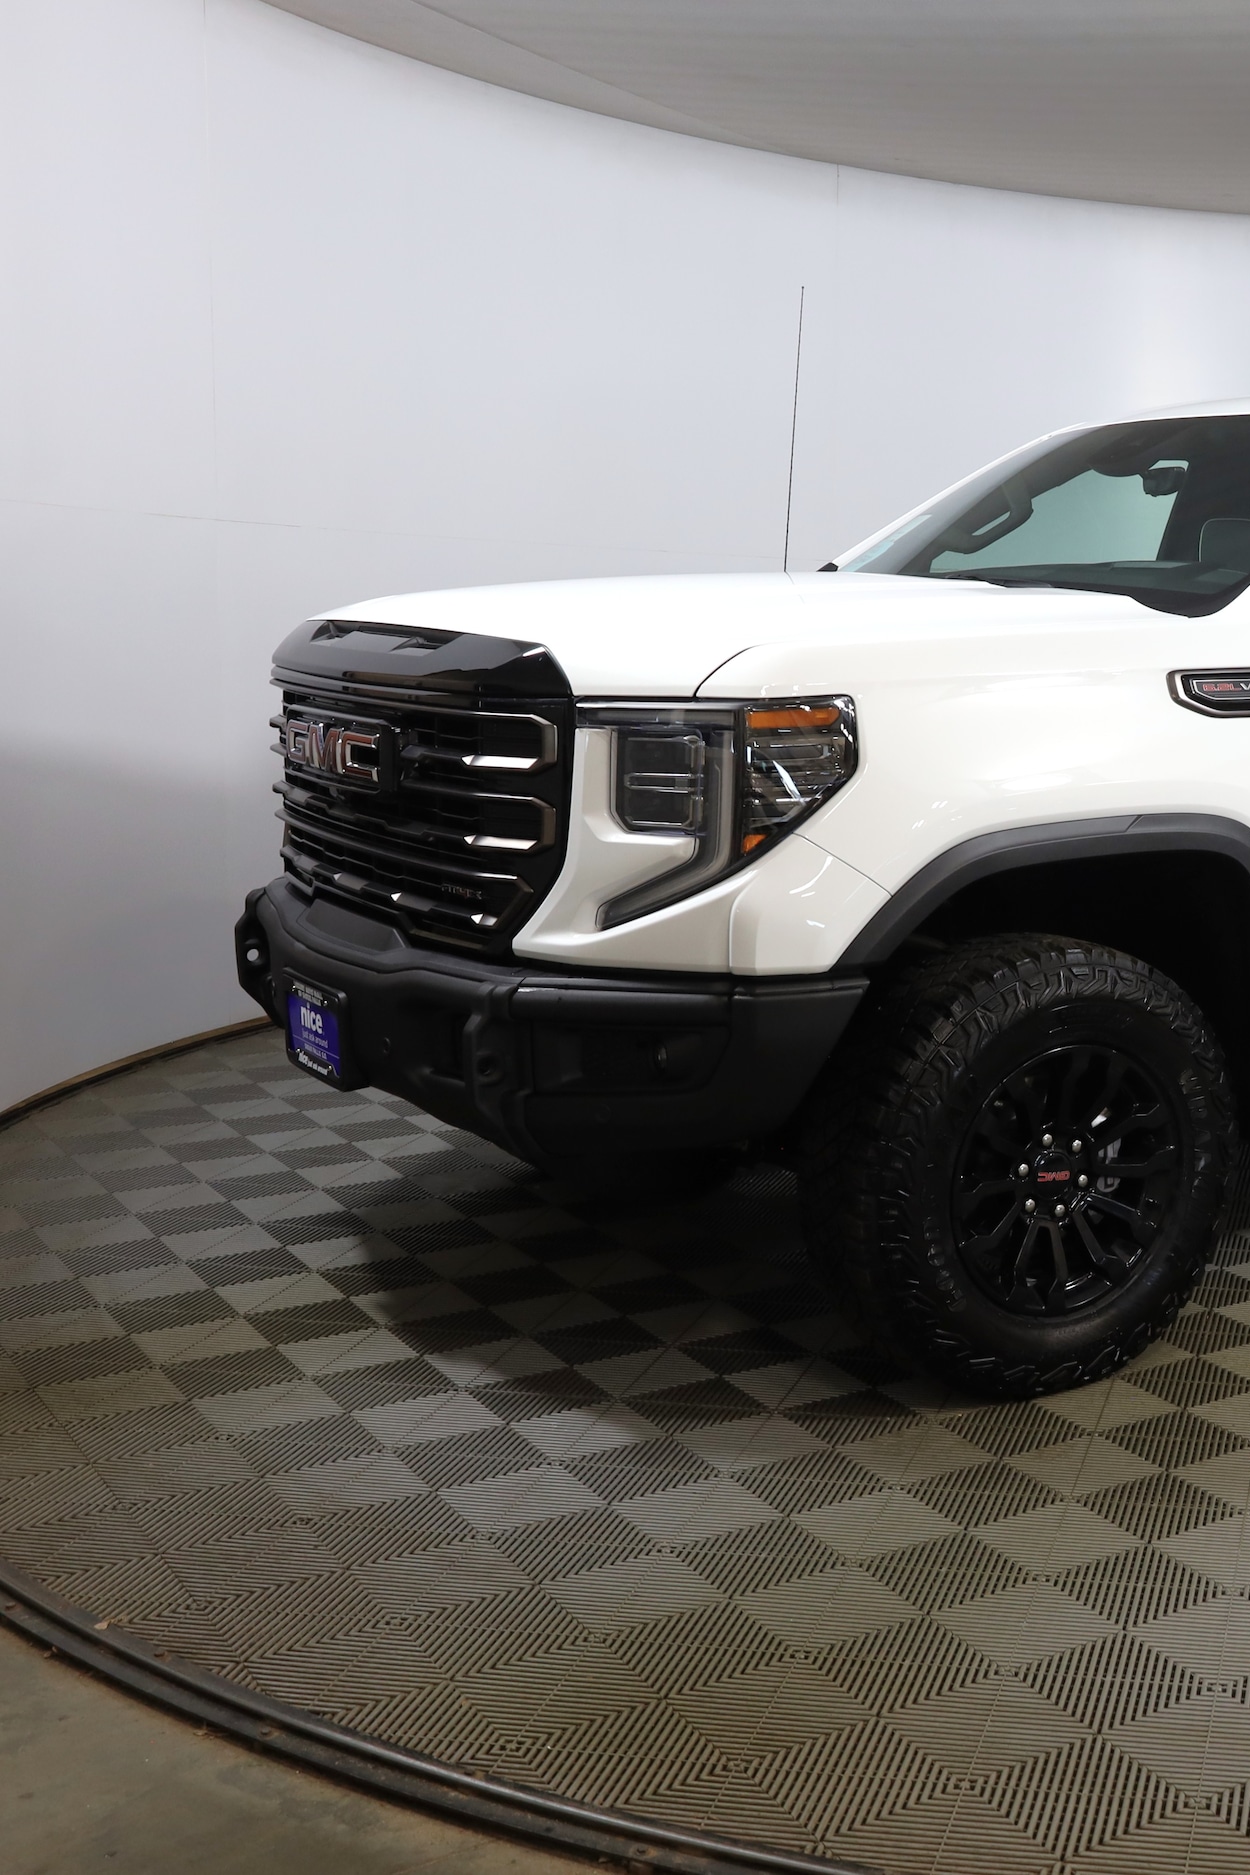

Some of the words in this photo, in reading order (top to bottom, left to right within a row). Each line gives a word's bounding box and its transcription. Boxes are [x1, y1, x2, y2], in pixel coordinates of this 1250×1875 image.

[286, 719, 380, 783] GMC
[301, 1002, 323, 1034] nice
[1037, 1170, 1071, 1182] GMC
